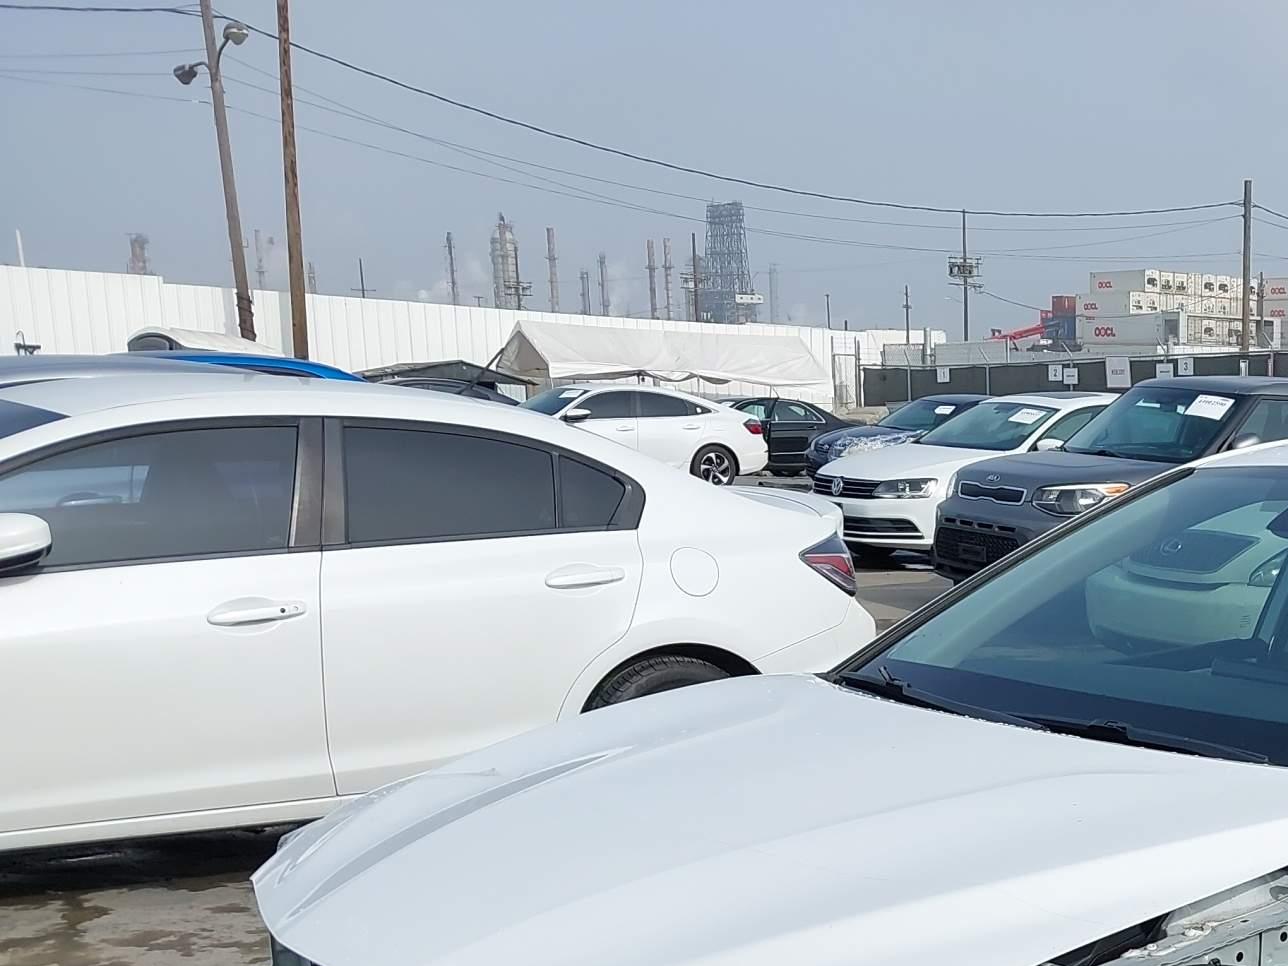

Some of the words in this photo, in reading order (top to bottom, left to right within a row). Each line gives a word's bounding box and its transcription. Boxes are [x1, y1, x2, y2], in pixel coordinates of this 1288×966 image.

[1097, 281, 1113, 289] OOCL
[1094, 326, 1116, 337] OOCL
[1183, 362, 1189, 371] 3
[1053, 368, 1058, 377] 2
